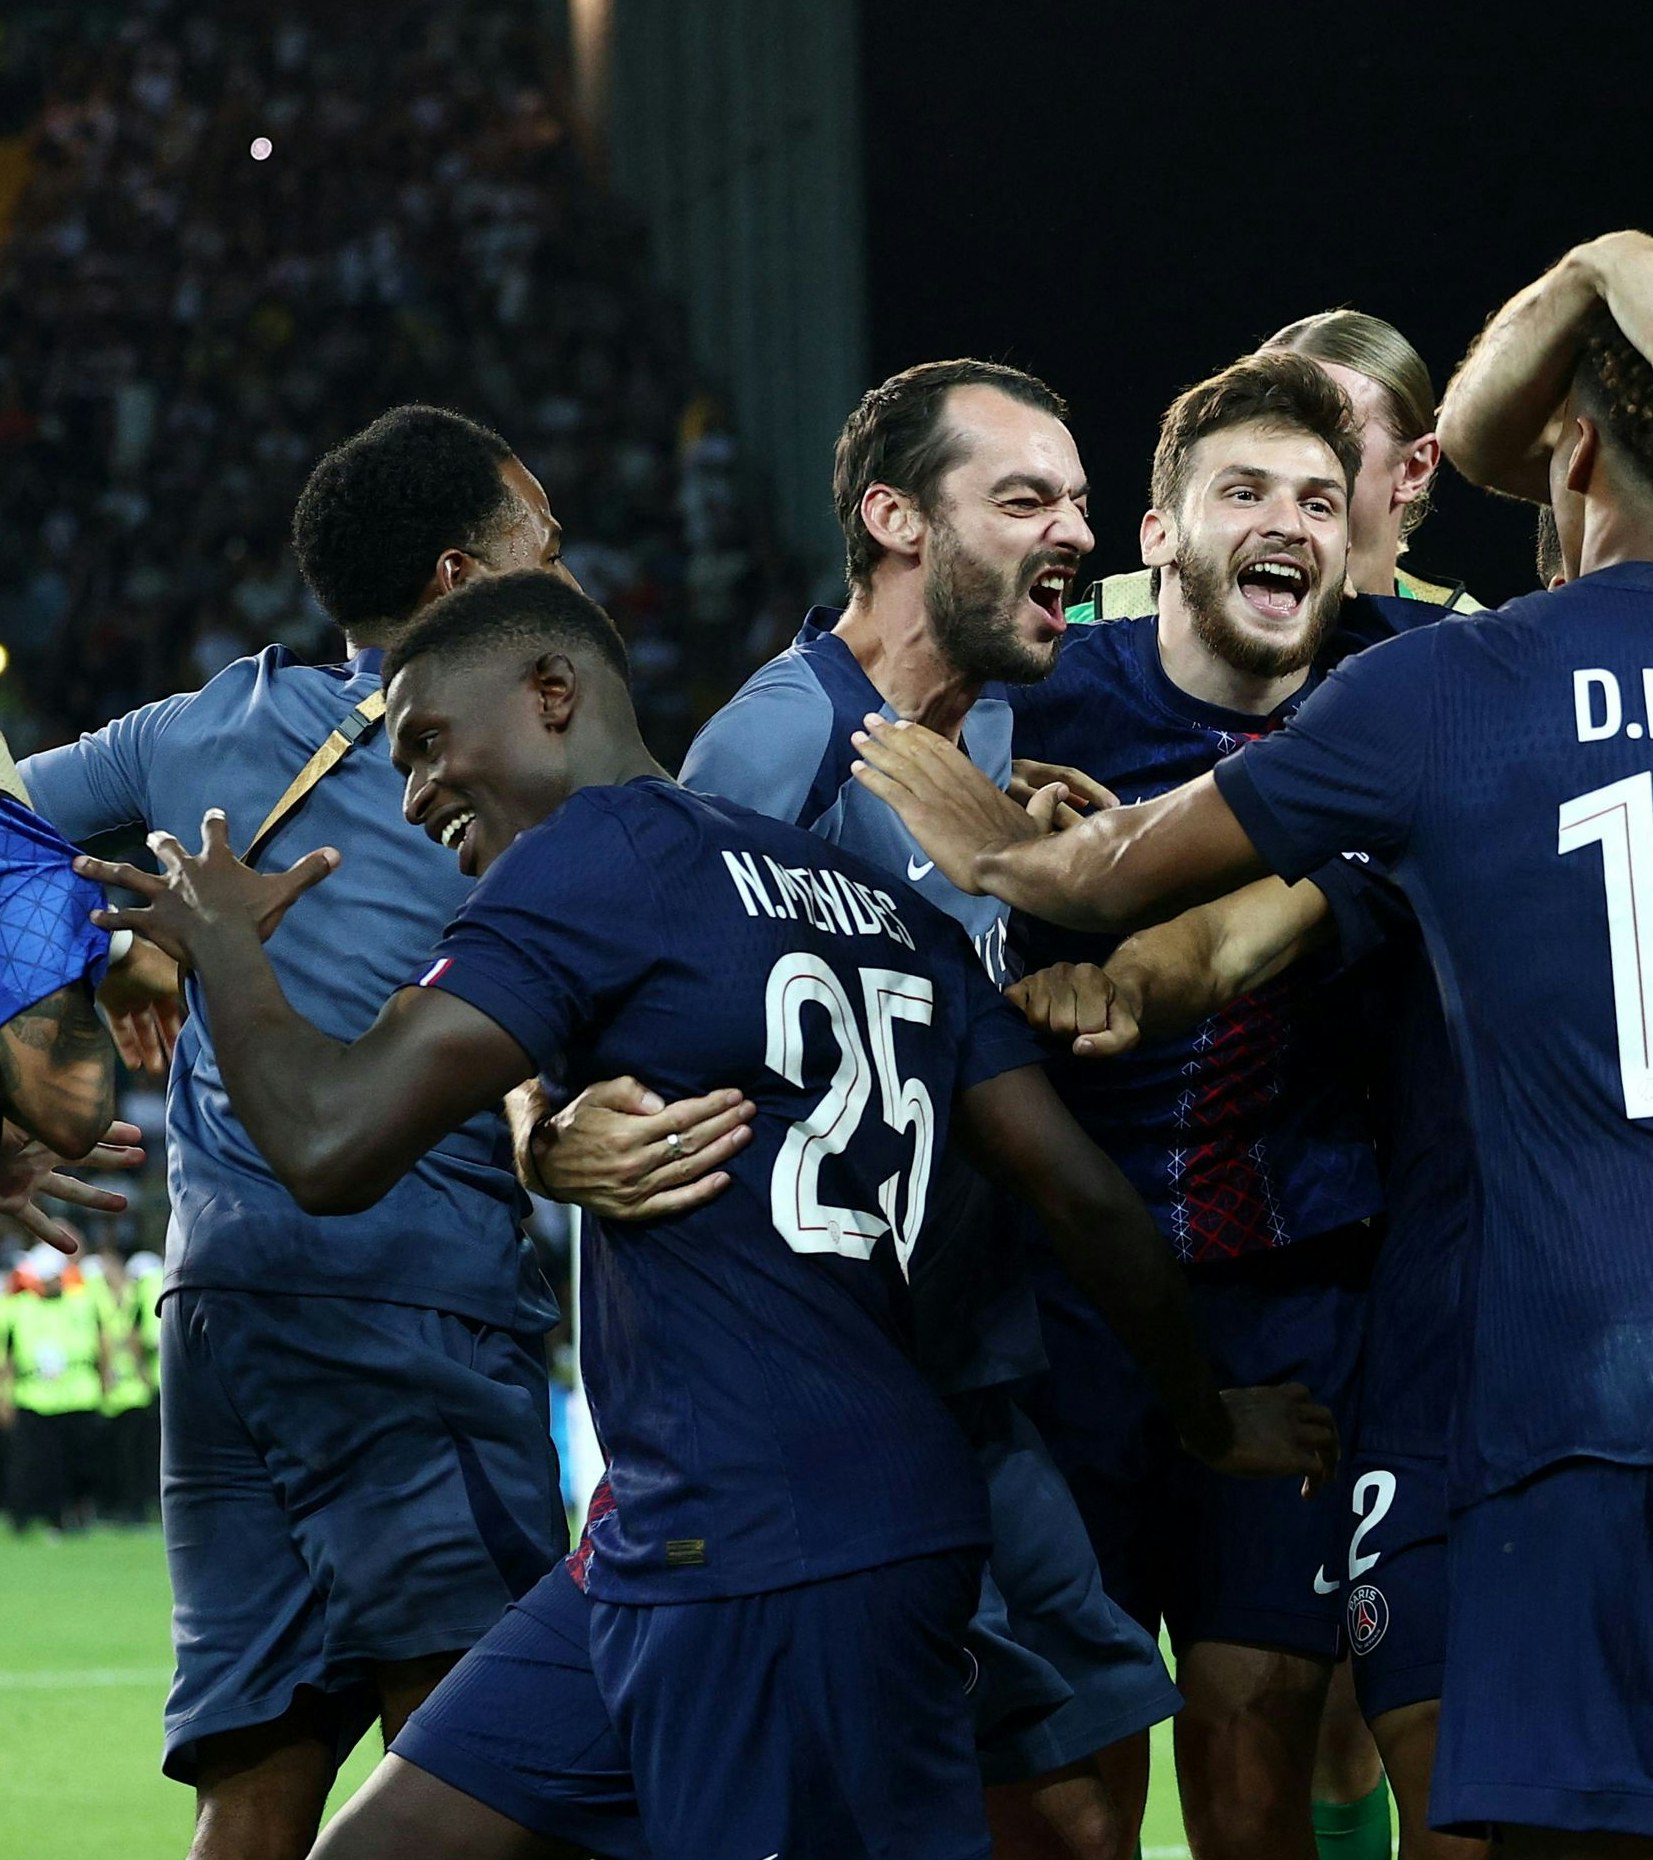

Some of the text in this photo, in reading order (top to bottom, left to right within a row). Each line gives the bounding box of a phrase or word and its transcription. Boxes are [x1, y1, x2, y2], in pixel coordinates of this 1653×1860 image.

[721, 851, 916, 951] N.MENDES
[765, 952, 934, 1286] 25
[1349, 1470, 1397, 1581] 2
